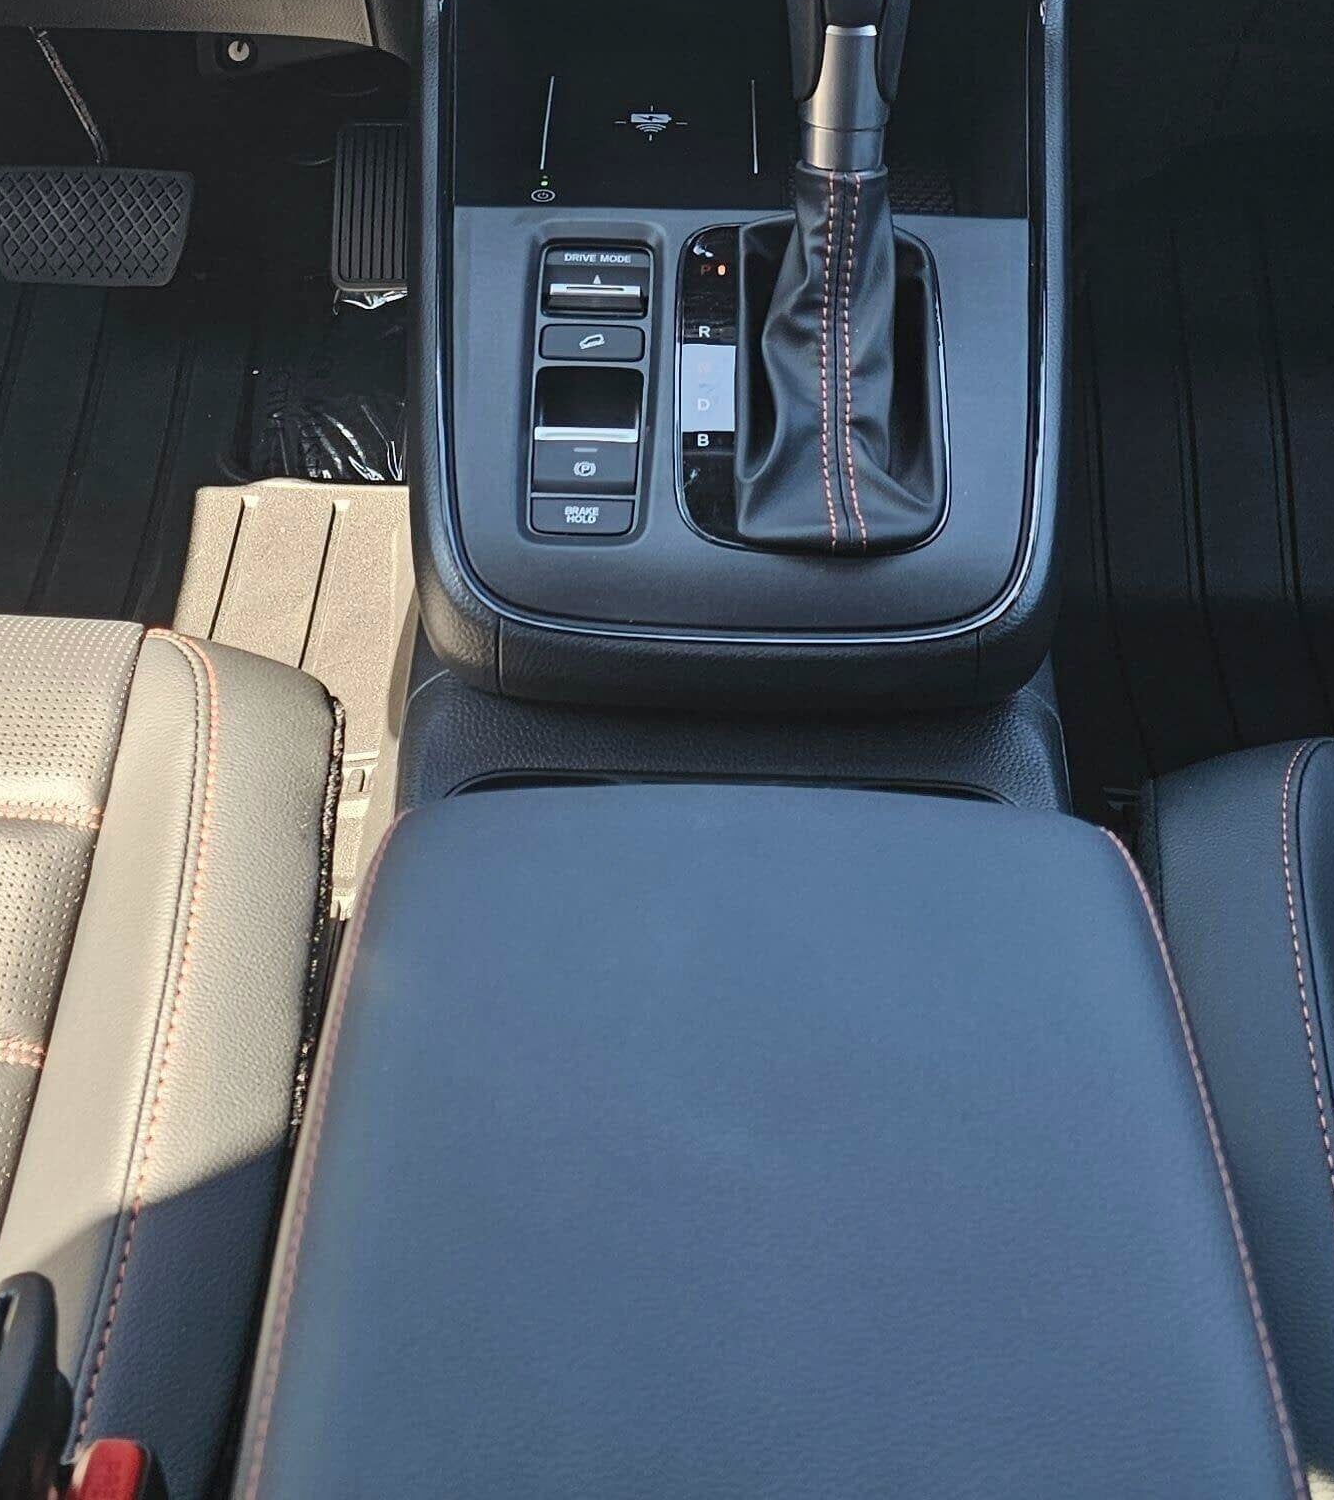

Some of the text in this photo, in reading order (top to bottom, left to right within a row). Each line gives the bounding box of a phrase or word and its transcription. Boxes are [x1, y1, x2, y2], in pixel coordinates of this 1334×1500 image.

[564, 253, 631, 264] DRIVE MODE
[698, 326, 710, 338] R
[698, 399, 710, 411] D
[697, 434, 710, 446] B
[564, 506, 599, 516] BRAKE
[566, 514, 596, 524] HOLD
